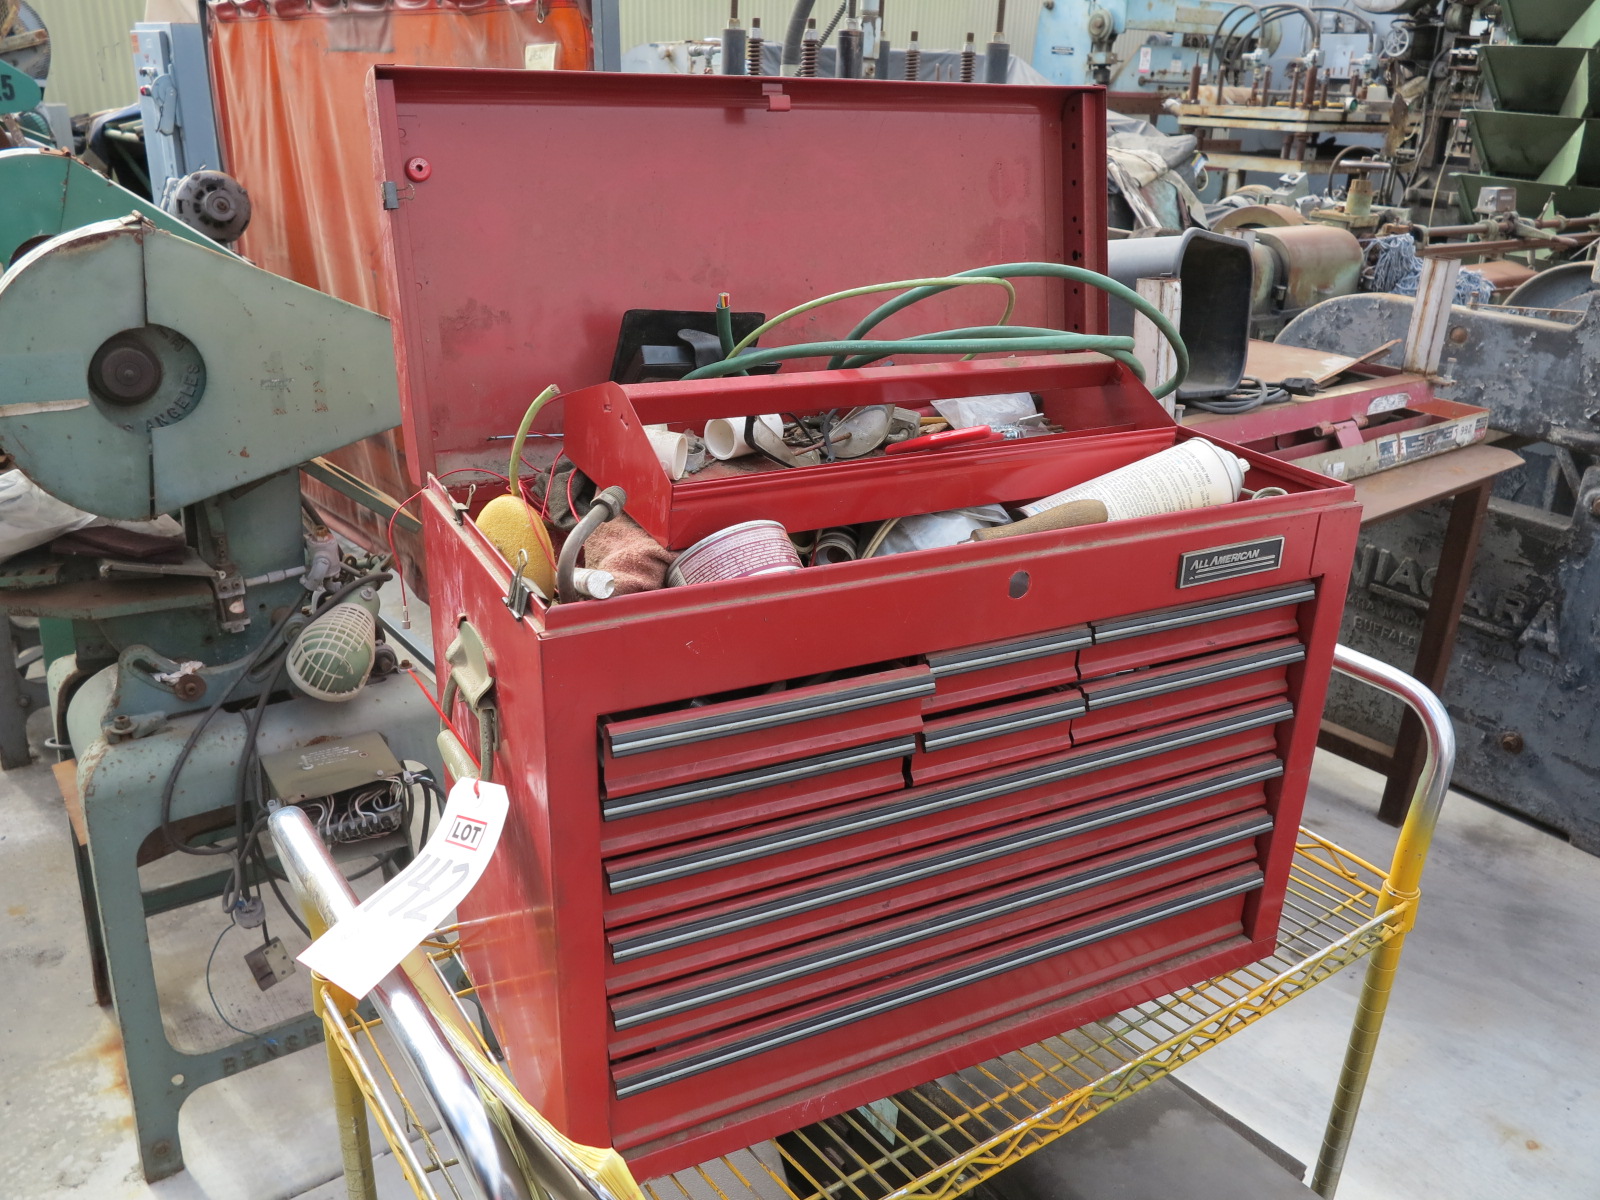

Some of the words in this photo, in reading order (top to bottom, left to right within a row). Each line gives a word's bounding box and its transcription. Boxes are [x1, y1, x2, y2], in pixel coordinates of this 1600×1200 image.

[1353, 615, 1416, 646] BUFFALO
[452, 821, 482, 844] LOT
[363, 854, 470, 922] 142
